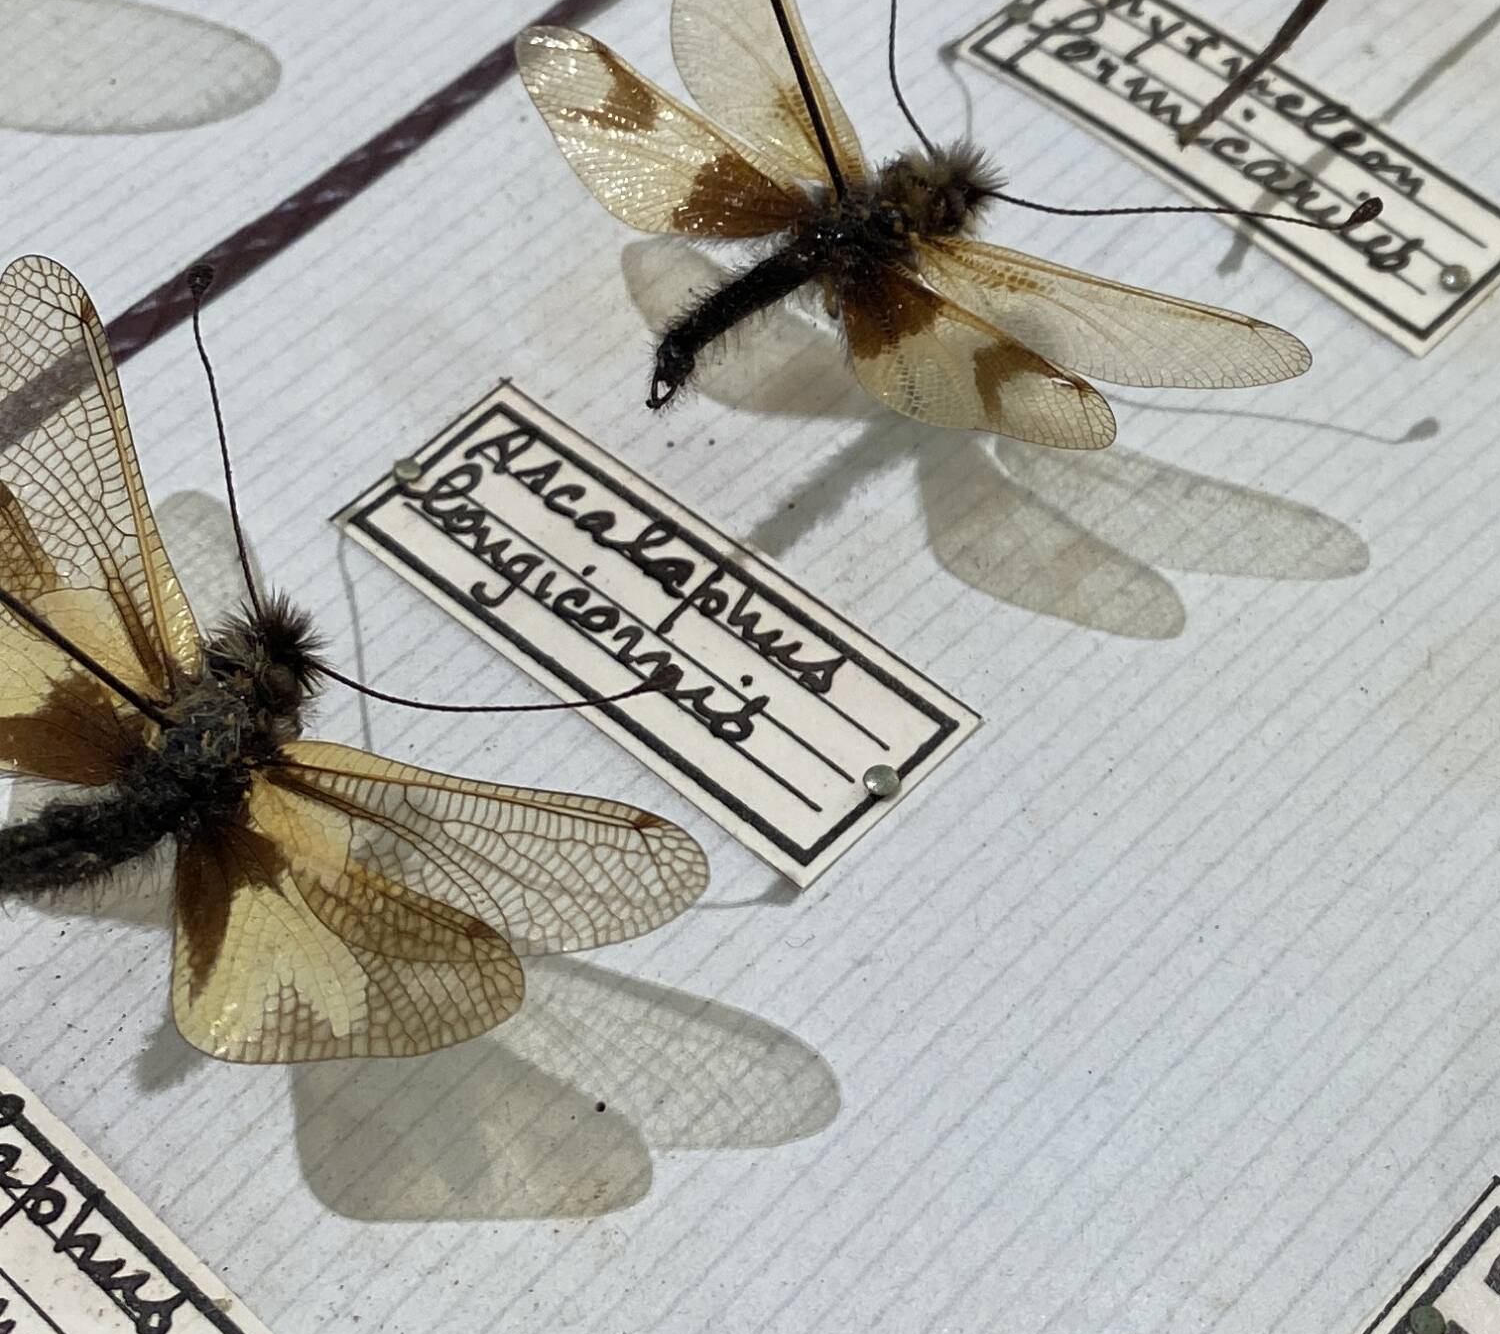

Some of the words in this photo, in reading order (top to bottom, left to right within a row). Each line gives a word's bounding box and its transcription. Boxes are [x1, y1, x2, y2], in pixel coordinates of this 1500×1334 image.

[1006, 4, 1424, 274] formcarius
[402, 463, 769, 742] longicornis
[464, 426, 851, 696] Ascalaphus
